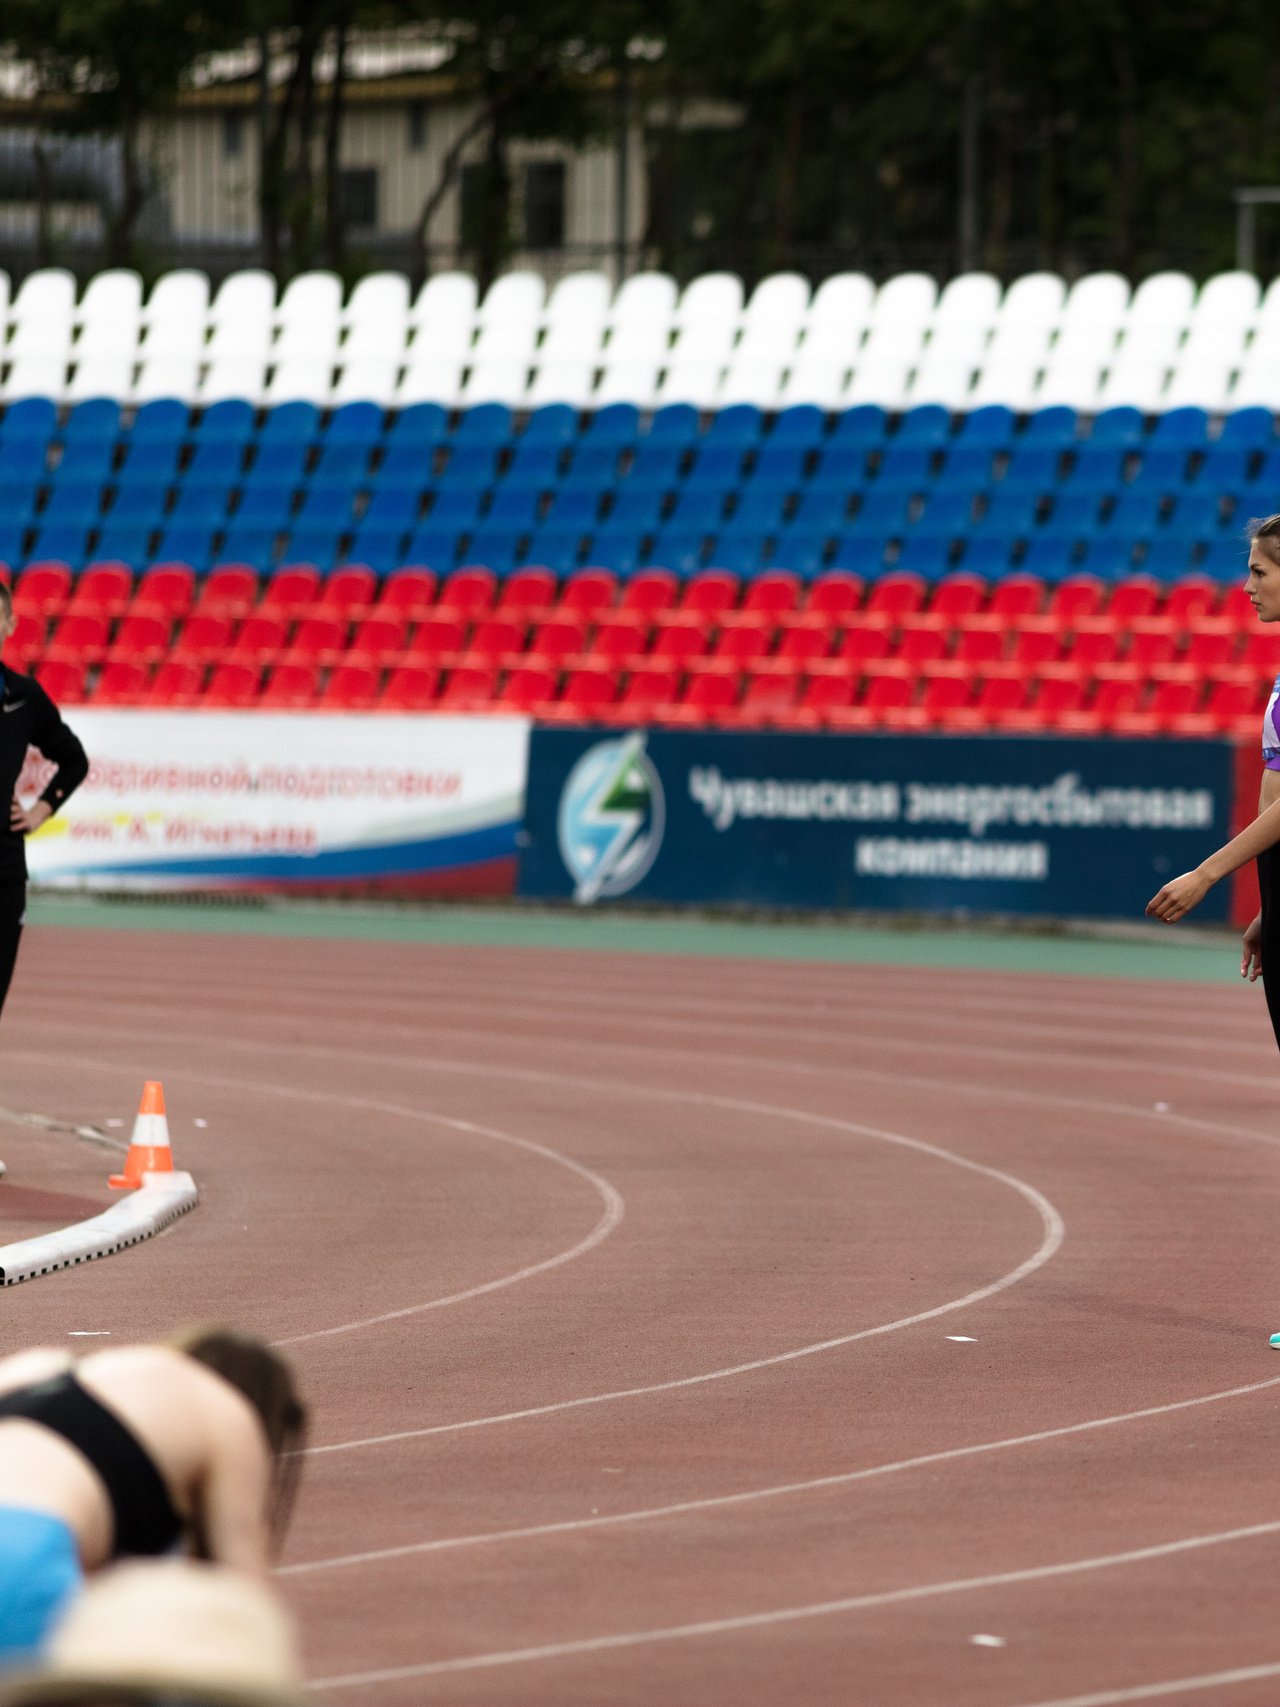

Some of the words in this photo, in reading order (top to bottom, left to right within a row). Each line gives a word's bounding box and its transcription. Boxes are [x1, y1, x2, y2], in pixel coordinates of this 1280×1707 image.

[689, 767, 899, 828] Чувашская
[906, 773, 1212, 834] энергосбытовая
[856, 838, 1047, 879] компания
